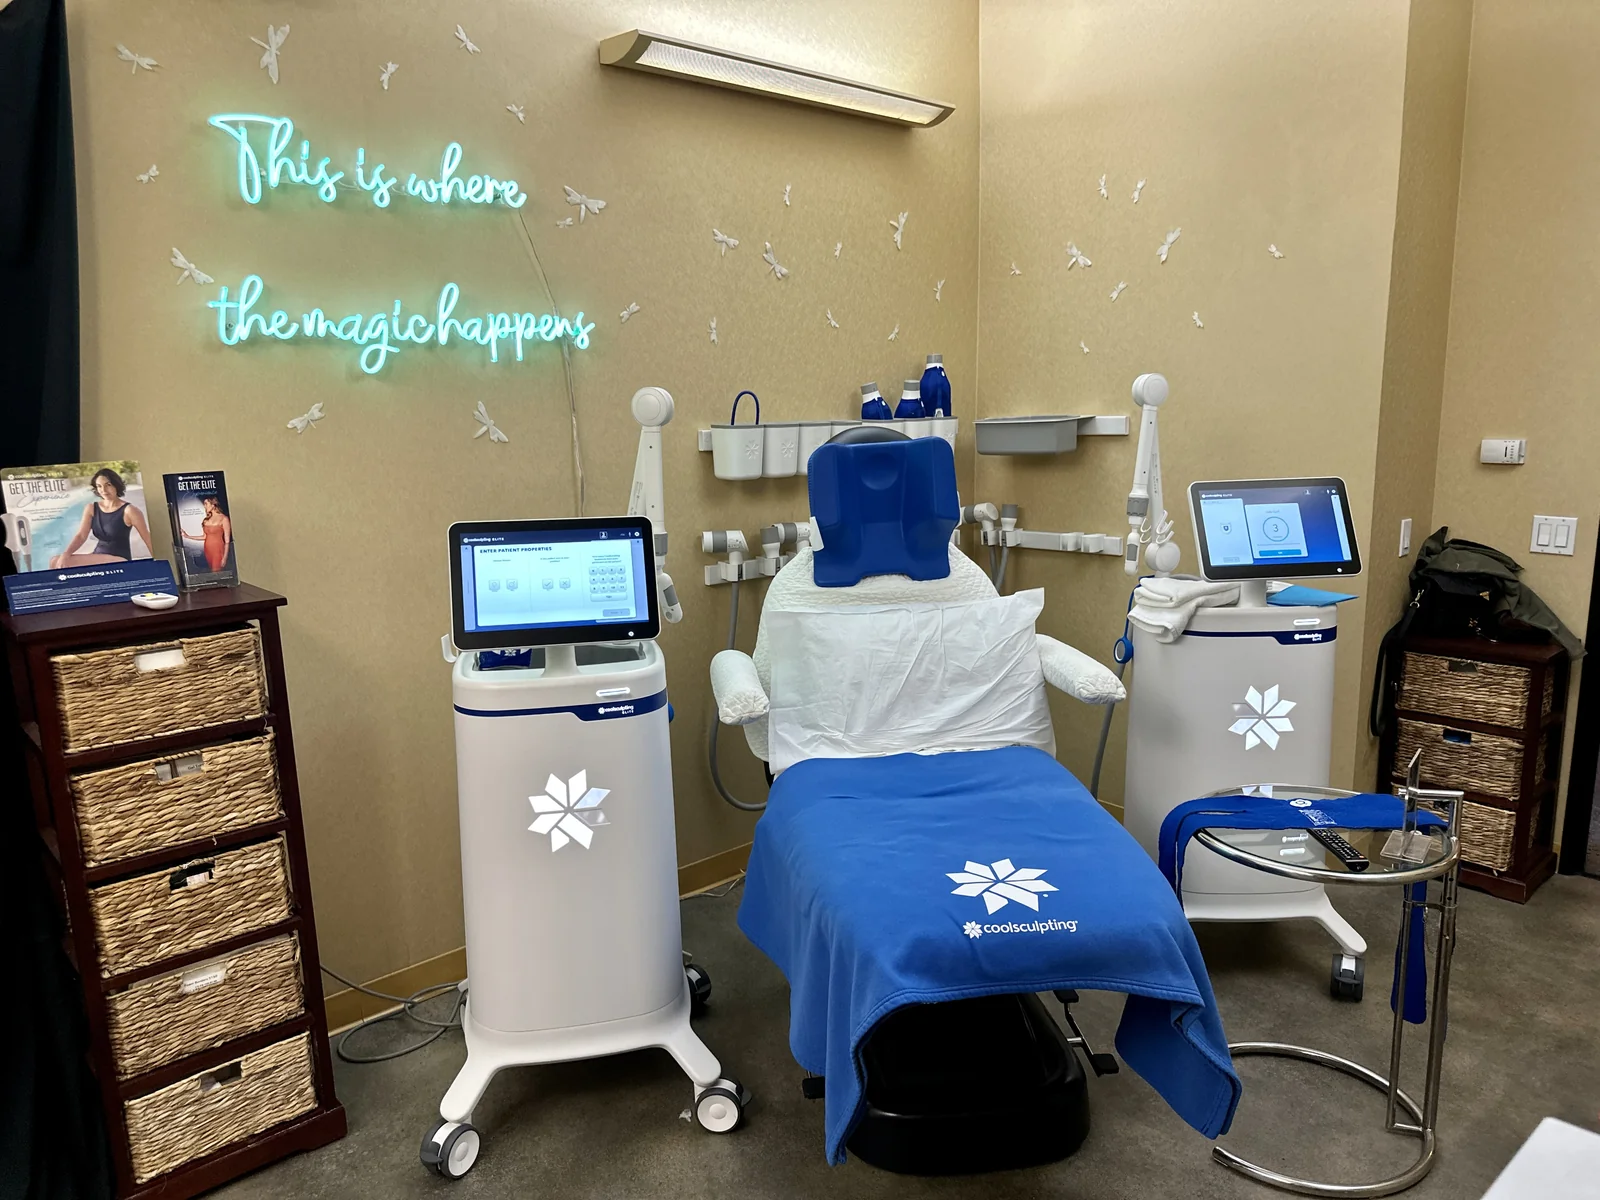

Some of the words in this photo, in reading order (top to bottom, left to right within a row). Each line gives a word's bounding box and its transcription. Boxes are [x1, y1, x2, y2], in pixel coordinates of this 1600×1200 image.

[208, 113, 344, 205] This
[355, 147, 397, 208] is
[406, 141, 528, 209] where
[206, 274, 299, 345] the
[301, 299, 437, 374] magic
[437, 282, 596, 362] happens
[9, 482, 25, 495] GET
[26, 480, 43, 494] THE
[43, 479, 66, 493] ELITE
[177, 481, 189, 491] GET
[189, 480, 201, 490] THE
[201, 479, 217, 490] ELITE
[1272, 523, 1279, 533] 3
[983, 918, 1078, 934] coolsculpting
